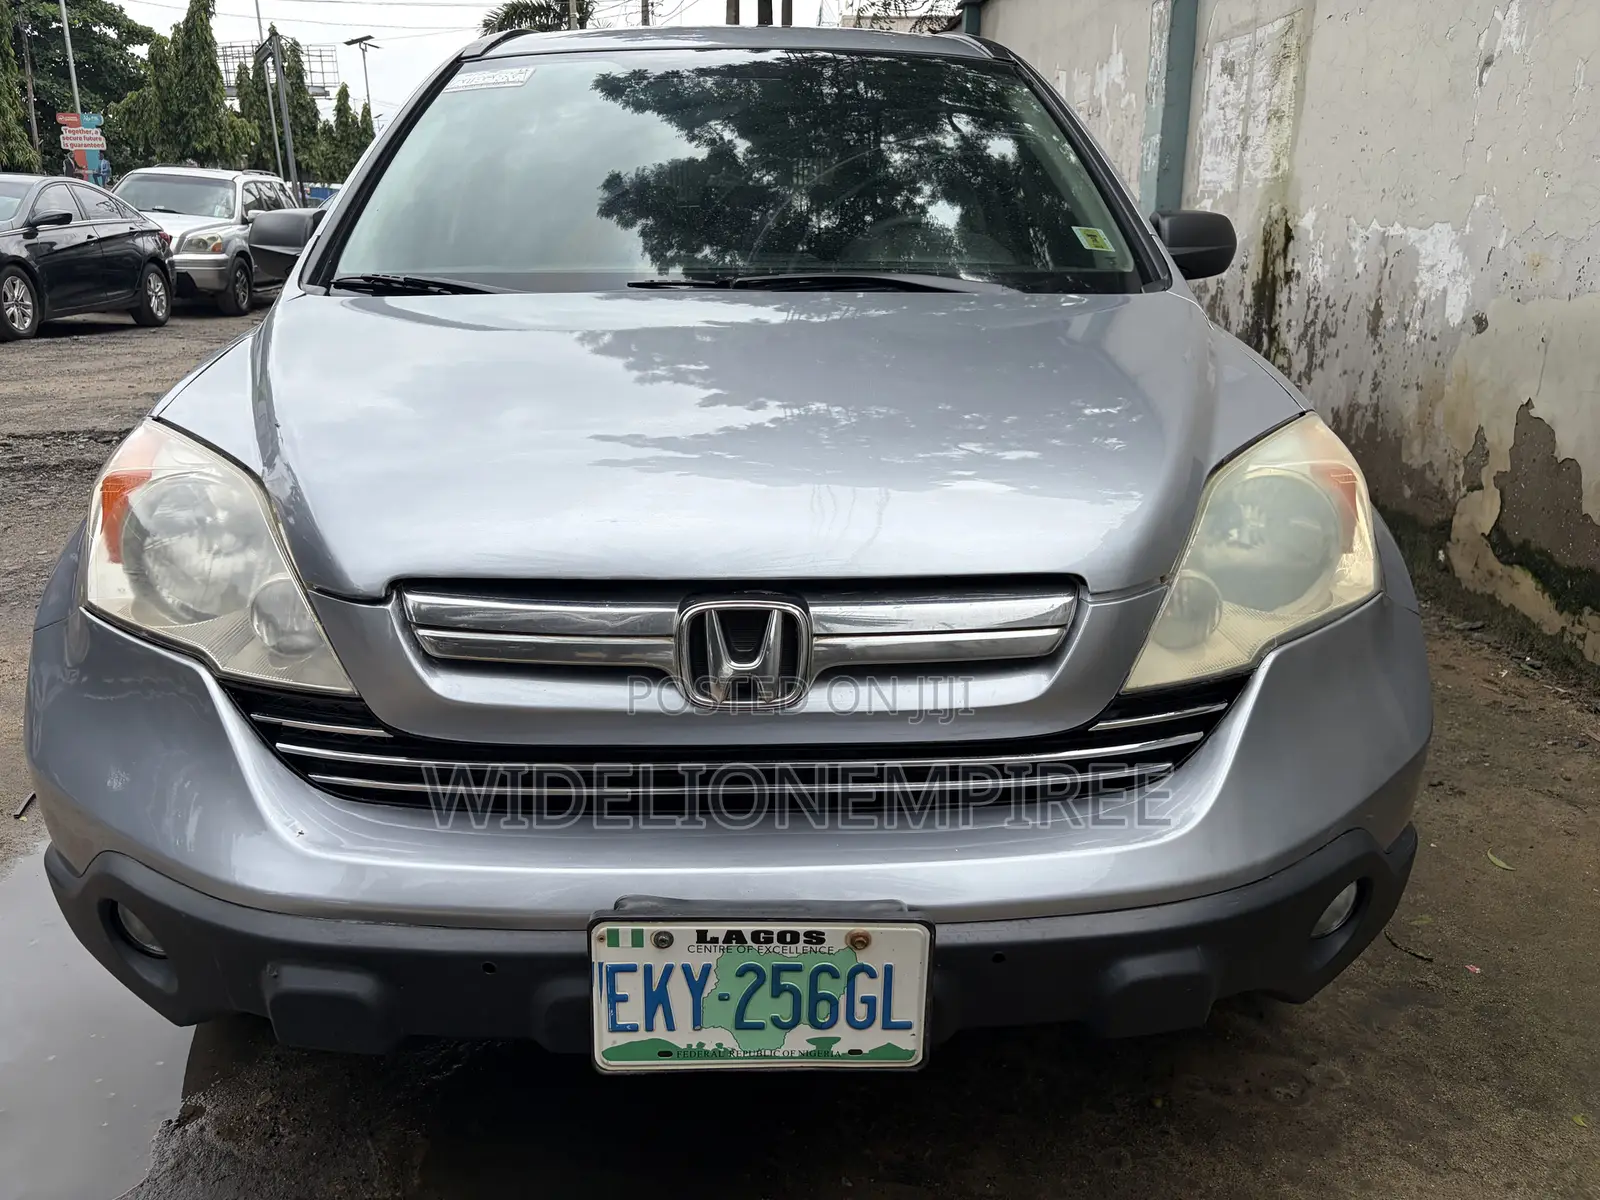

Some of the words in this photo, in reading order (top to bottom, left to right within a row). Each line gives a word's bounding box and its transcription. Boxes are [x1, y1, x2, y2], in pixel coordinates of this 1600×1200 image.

[70, 141, 104, 149] guaranteed
[696, 929, 826, 945] LAGOS
[687, 944, 733, 954] CENTRE
[736, 944, 754, 954] OF
[757, 945, 834, 955] EXCELLENCE
[606, 962, 912, 1032] EKY-256GL
[676, 1049, 725, 1059] FEDERAL
[728, 1049, 781, 1058] REPUBLIC
[782, 1049, 795, 1058] OF
[798, 1049, 842, 1059] NIGERIA
